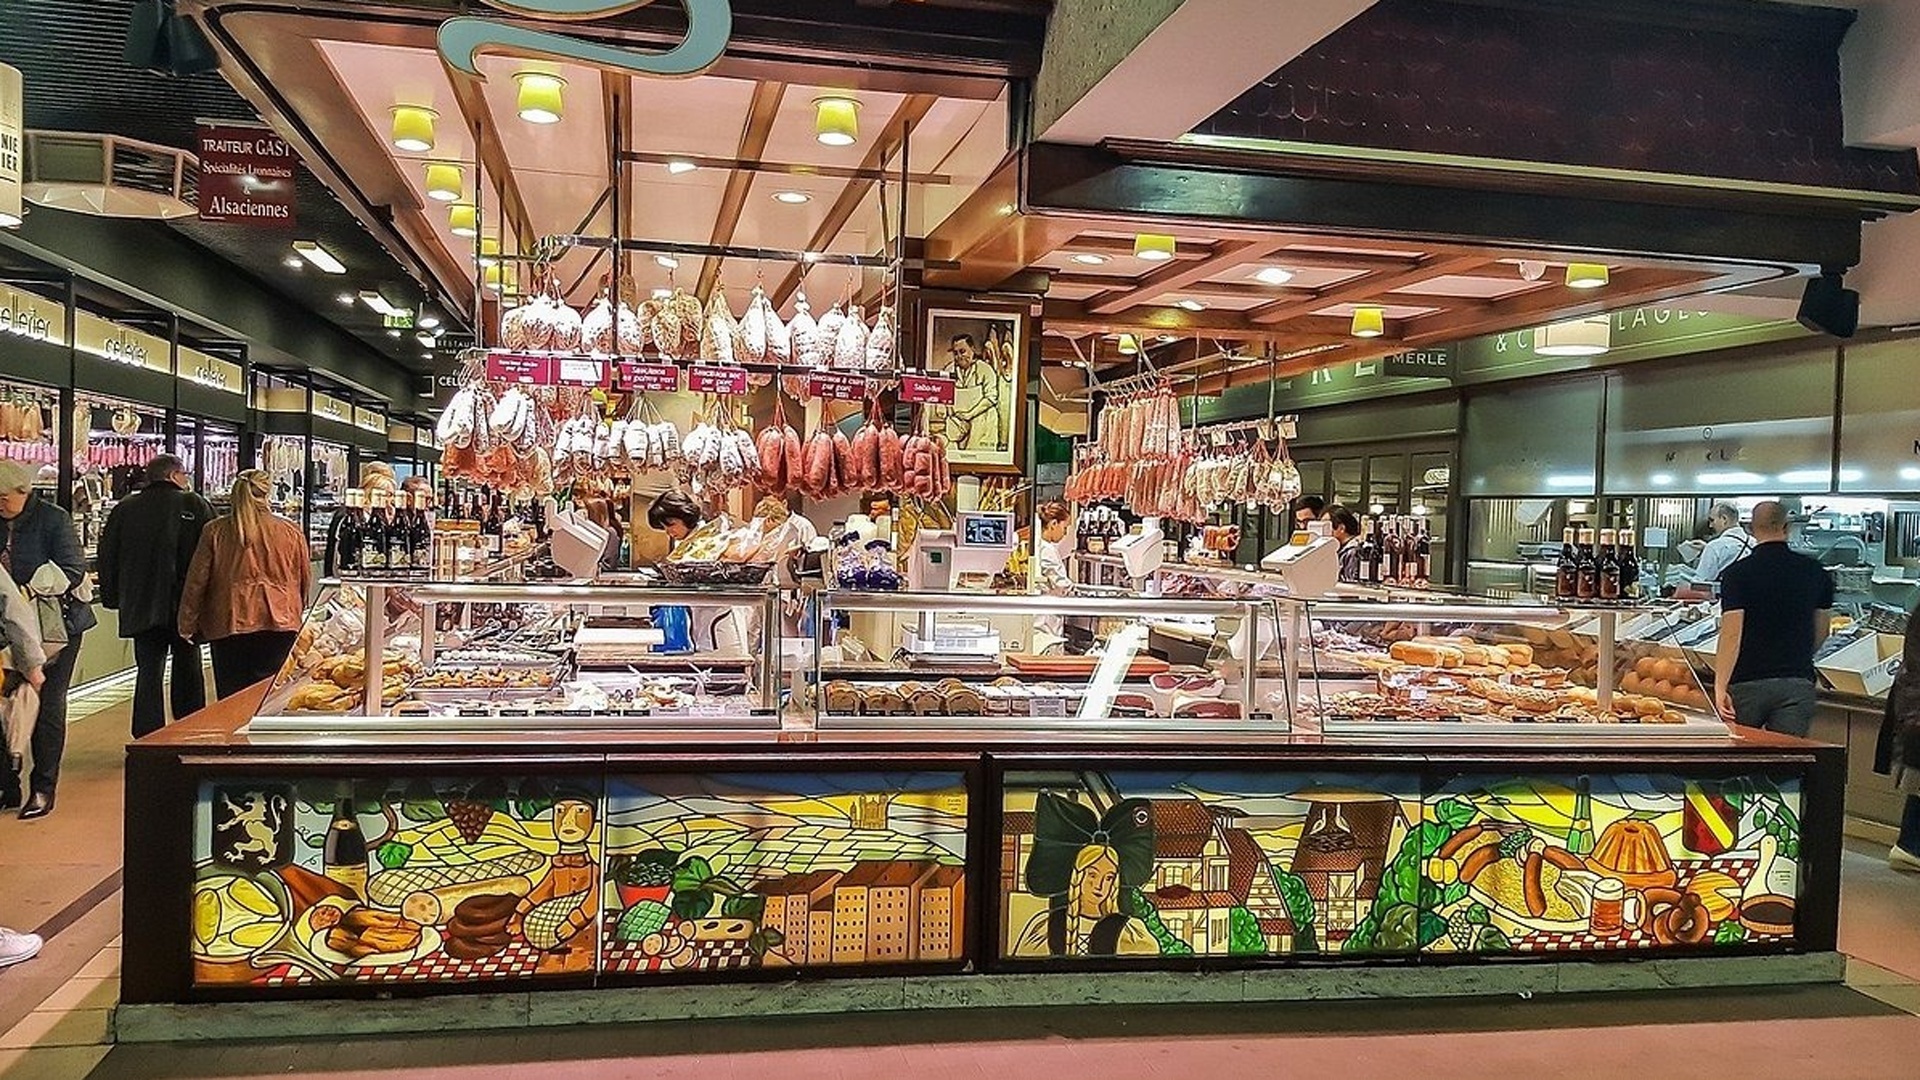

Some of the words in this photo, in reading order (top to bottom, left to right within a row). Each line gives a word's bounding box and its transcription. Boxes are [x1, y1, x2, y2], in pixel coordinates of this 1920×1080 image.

[202, 139, 253, 155] TRAITEUR
[209, 195, 289, 218] Alsaciennes
[1391, 352, 1448, 366] MERLE
